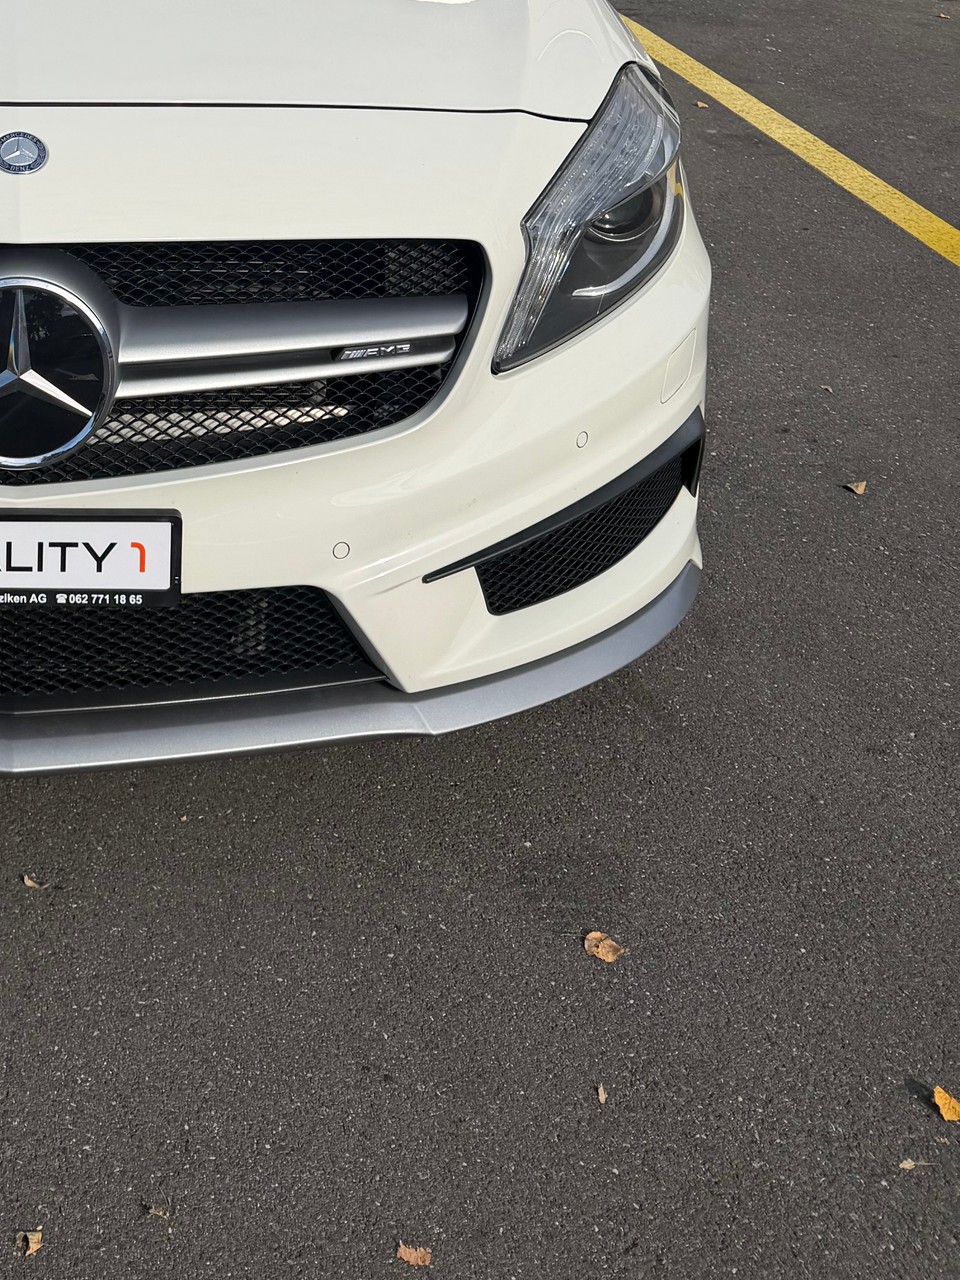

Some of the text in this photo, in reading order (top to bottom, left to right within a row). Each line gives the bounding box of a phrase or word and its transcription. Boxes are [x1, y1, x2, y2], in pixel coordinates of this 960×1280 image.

[29, 593, 47, 604] AG
[68, 593, 89, 604] 062
[91, 593, 110, 605] 771
[114, 594, 126, 605] 18
[129, 594, 143, 605] 65
